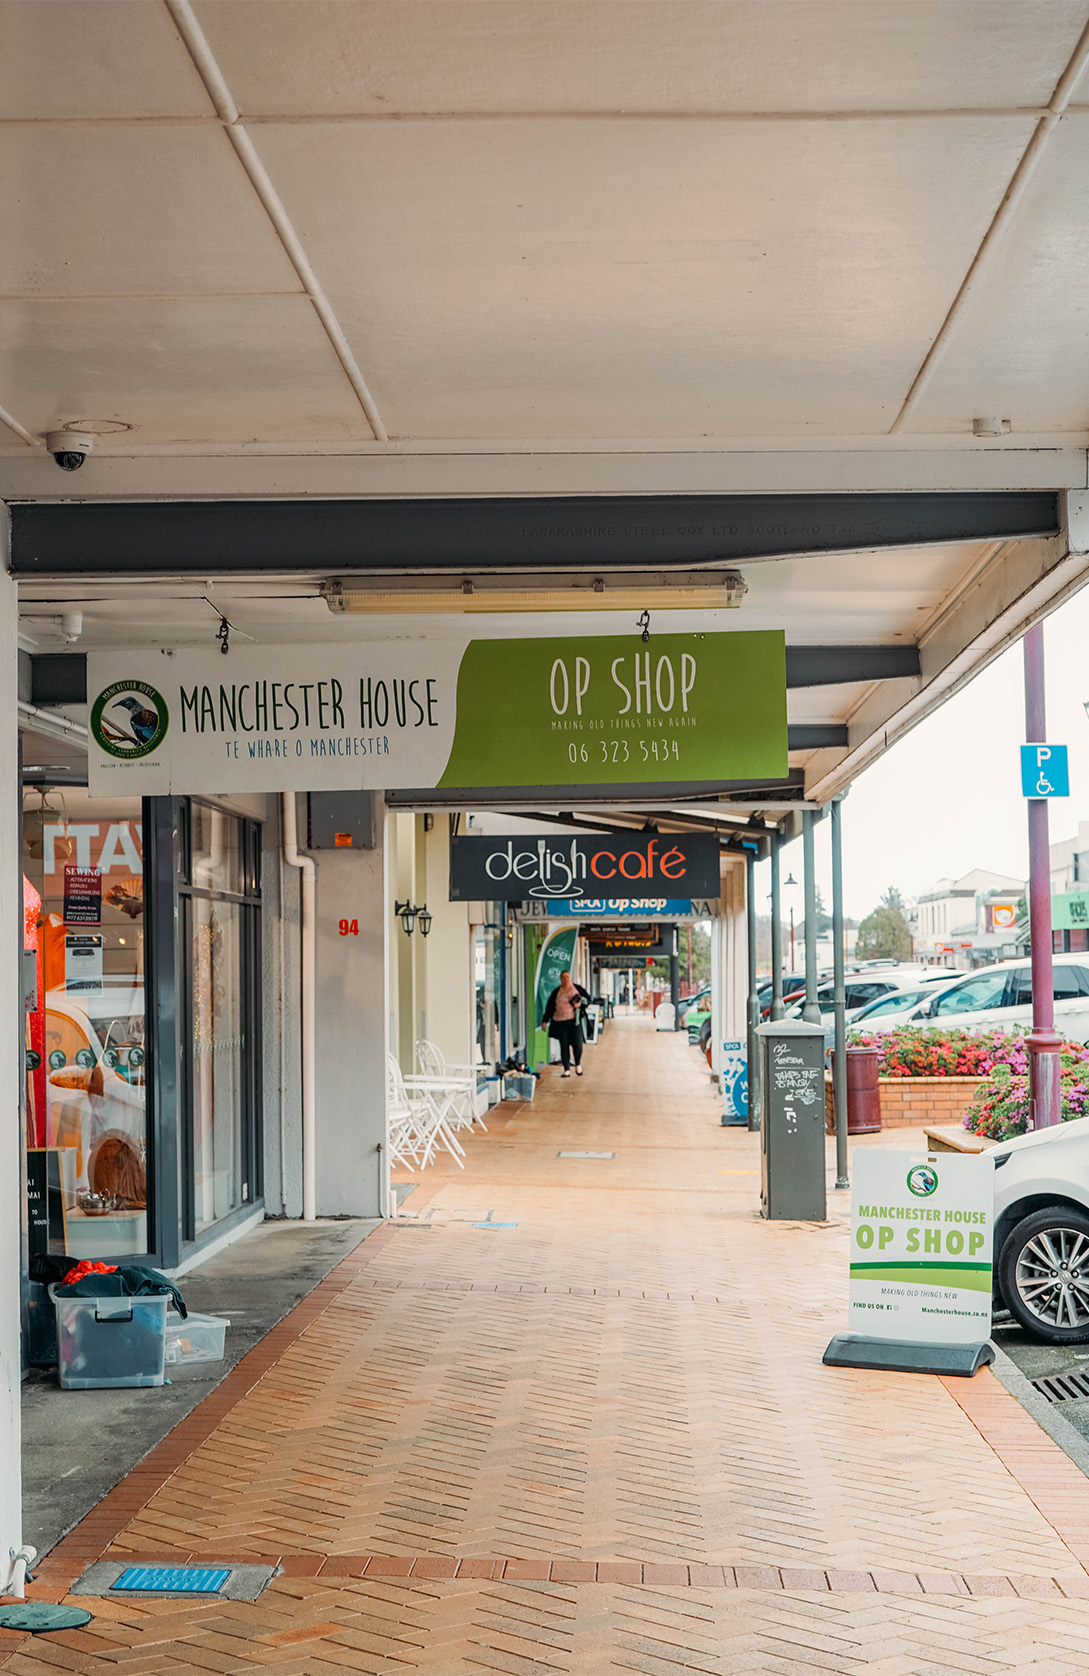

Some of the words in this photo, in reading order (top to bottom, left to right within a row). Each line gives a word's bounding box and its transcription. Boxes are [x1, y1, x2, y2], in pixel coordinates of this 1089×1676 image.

[522, 527, 617, 537] LANARKSHIRE
[623, 526, 671, 536] STEEL
[102, 682, 136, 700] MANCHESTER
[550, 656, 590, 716] OP
[611, 651, 697, 715] SHOP
[180, 677, 345, 734] MANCHESTER
[360, 677, 439, 729] HOUSE
[551, 720, 584, 731] MAKING
[589, 719, 605, 730] OLD
[610, 718, 641, 729] THINGS
[646, 718, 664, 728] NEW
[668, 717, 697, 727] AGAIN
[225, 740, 240, 759] TE
[248, 738, 288, 758] WHARE
[296, 738, 303, 758] O
[310, 736, 390, 757] MANCHESTER
[568, 743, 589, 764] 06
[600, 740, 630, 763] 323
[640, 739, 680, 762] 5434
[1037, 748, 1052, 767] P
[66, 867, 100, 876] SEWING
[608, 899, 628, 912] Op
[338, 918, 360, 936] 94
[546, 948, 571, 962] OPEN
[859, 1205, 941, 1222] MANCHESTER
[944, 1210, 986, 1224] HOUSE
[856, 1224, 895, 1250] OP
[905, 1227, 985, 1256] SHOP
[881, 1288, 905, 1296] MAKING
[920, 1290, 942, 1299] THINGS
[944, 1292, 958, 1300] NEW
[921, 1307, 988, 1318] Manchesterhouse.co.nz
